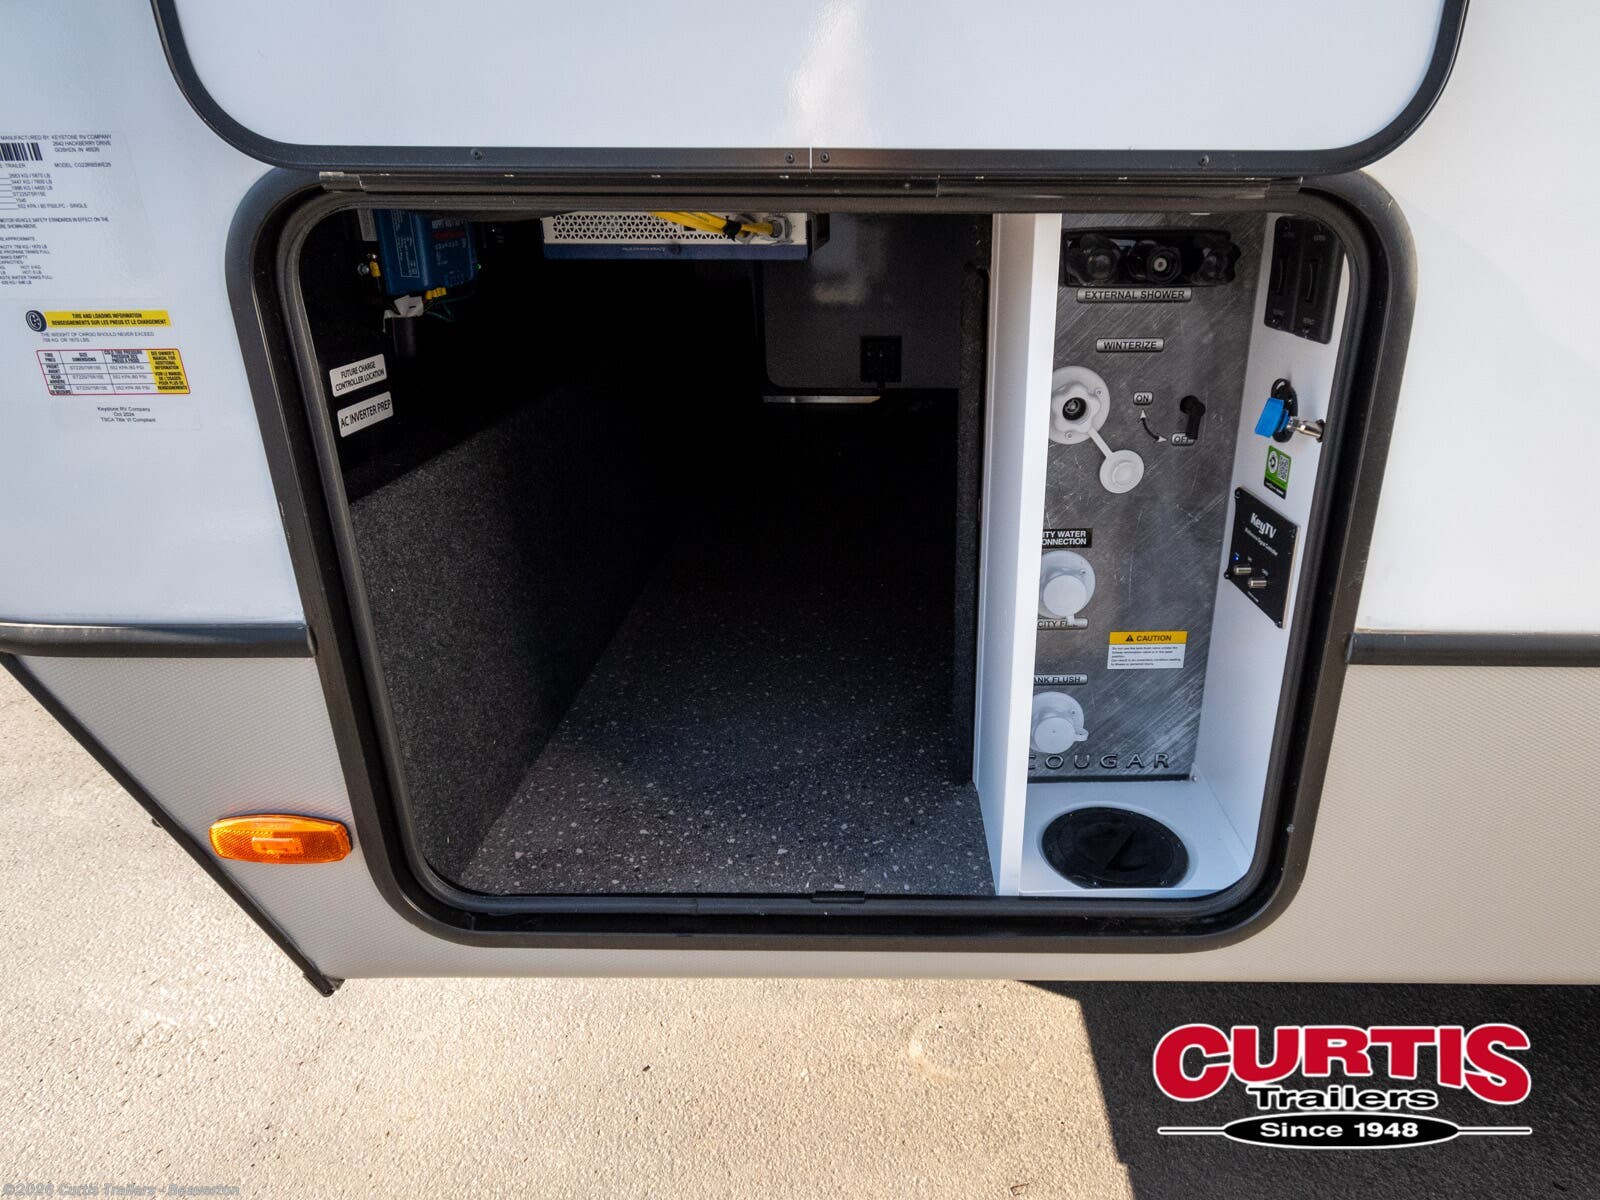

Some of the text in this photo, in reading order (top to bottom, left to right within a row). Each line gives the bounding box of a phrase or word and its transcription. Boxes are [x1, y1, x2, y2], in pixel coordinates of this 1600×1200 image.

[1085, 290, 1185, 300] EXTERNAL SHOWER
[1103, 342, 1157, 350] WINTERIZE
[341, 361, 376, 379] FUTURE CHARGE
[336, 368, 384, 391] CONTROLLER LOCATION
[341, 399, 391, 428] AC INVERTER PREP
[1174, 436, 1193, 444] OF
[1250, 512, 1277, 538] KeyTV
